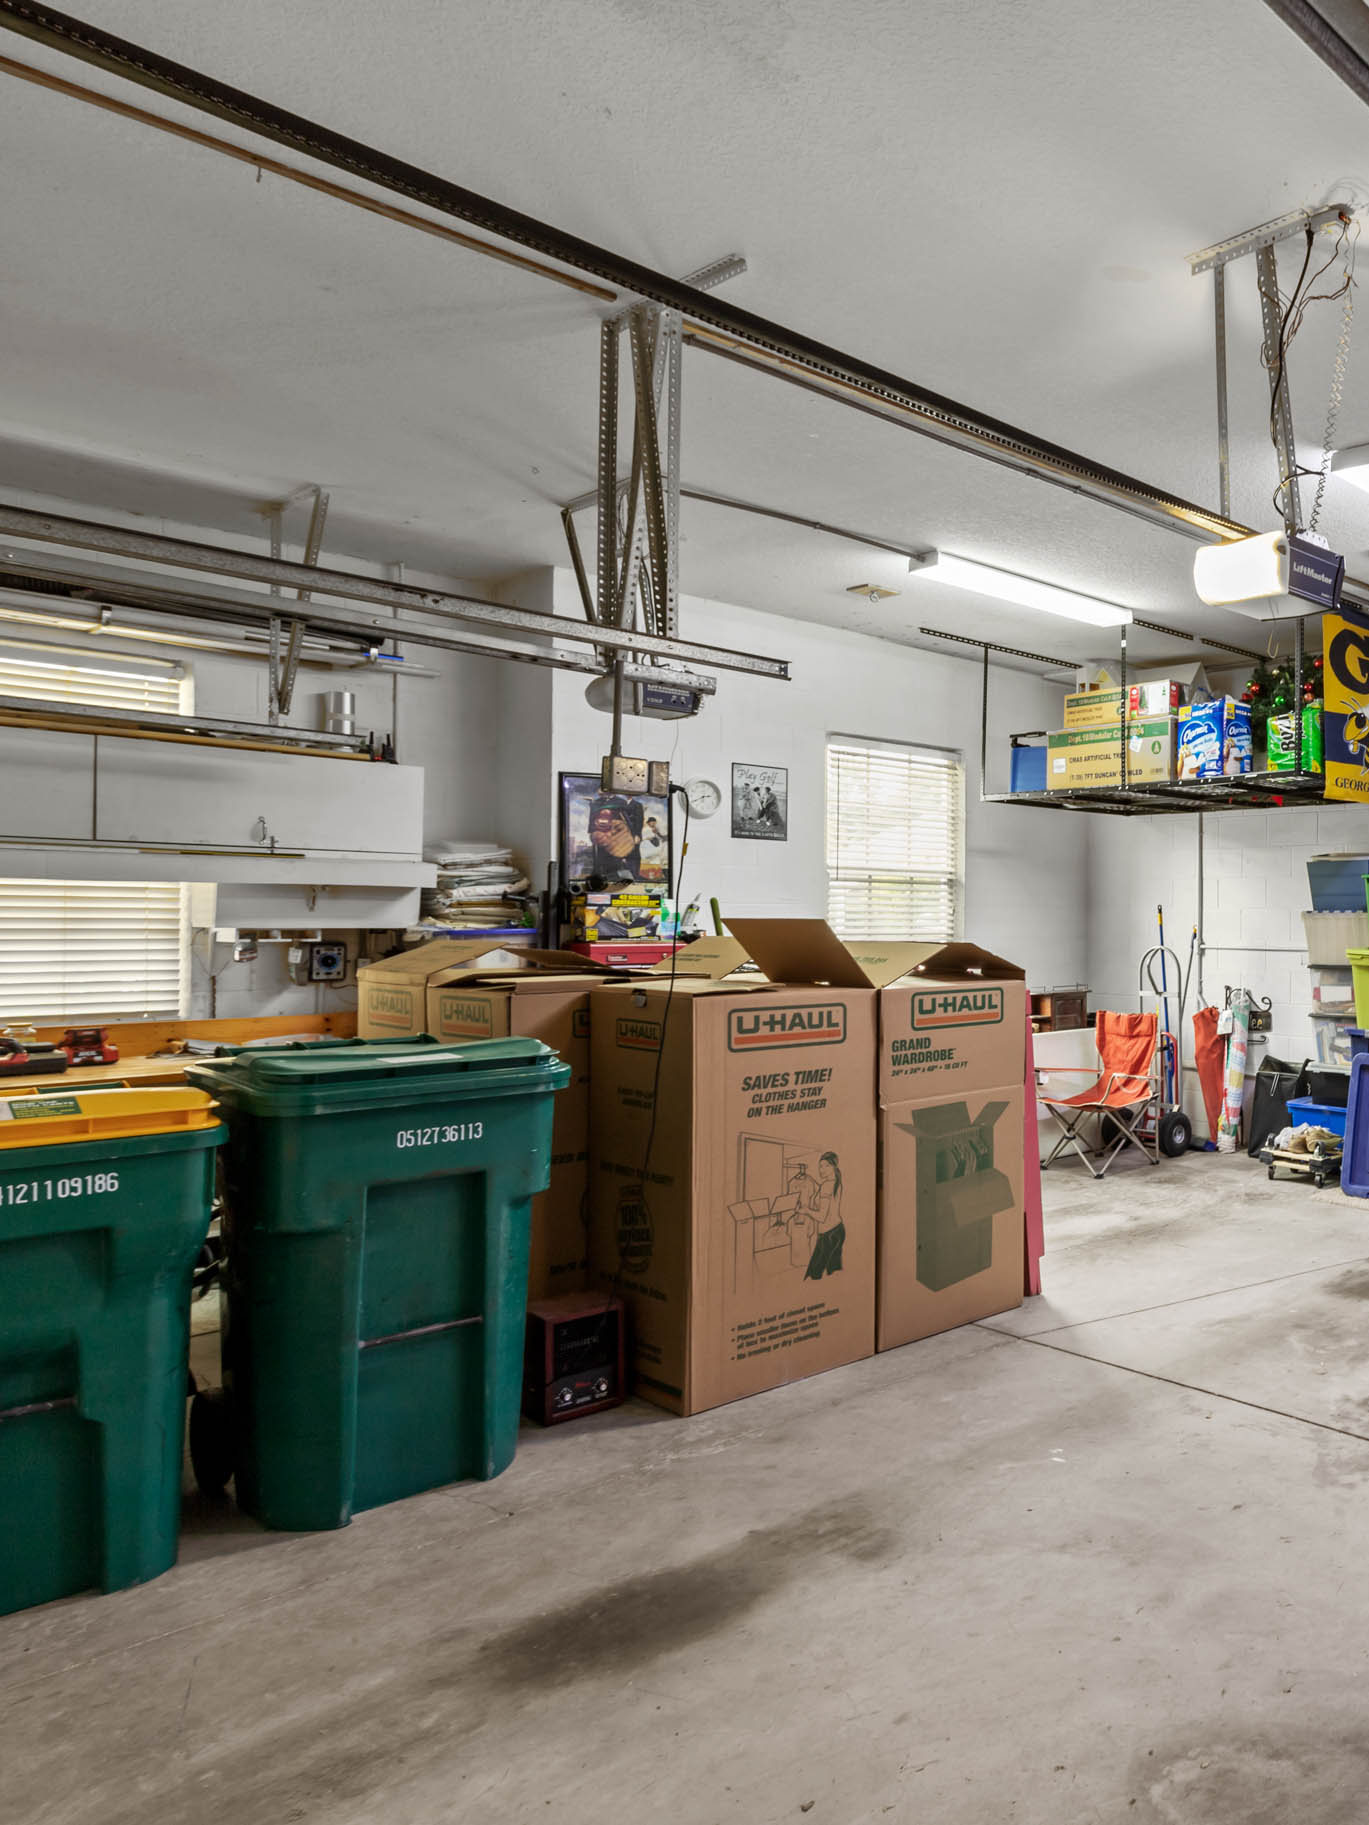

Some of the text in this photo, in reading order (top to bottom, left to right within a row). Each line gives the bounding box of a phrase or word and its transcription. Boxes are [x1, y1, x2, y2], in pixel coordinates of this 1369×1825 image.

[1293, 560, 1332, 585] LiftMaster
[442, 998, 489, 1025] U-HAUL
[918, 992, 999, 1015] U-HAUL
[736, 1009, 840, 1035] U-HAUL
[891, 1037, 932, 1053] GRAND
[891, 1048, 955, 1067] WARDROBE
[741, 1067, 833, 1092] SAVES TIME!
[747, 1098, 827, 1118] ON THE HANGER
[752, 1086, 824, 1105] CLOTHES STAY
[396, 1121, 484, 1149] 0512736113
[0, 1172, 120, 1207] 121109186
